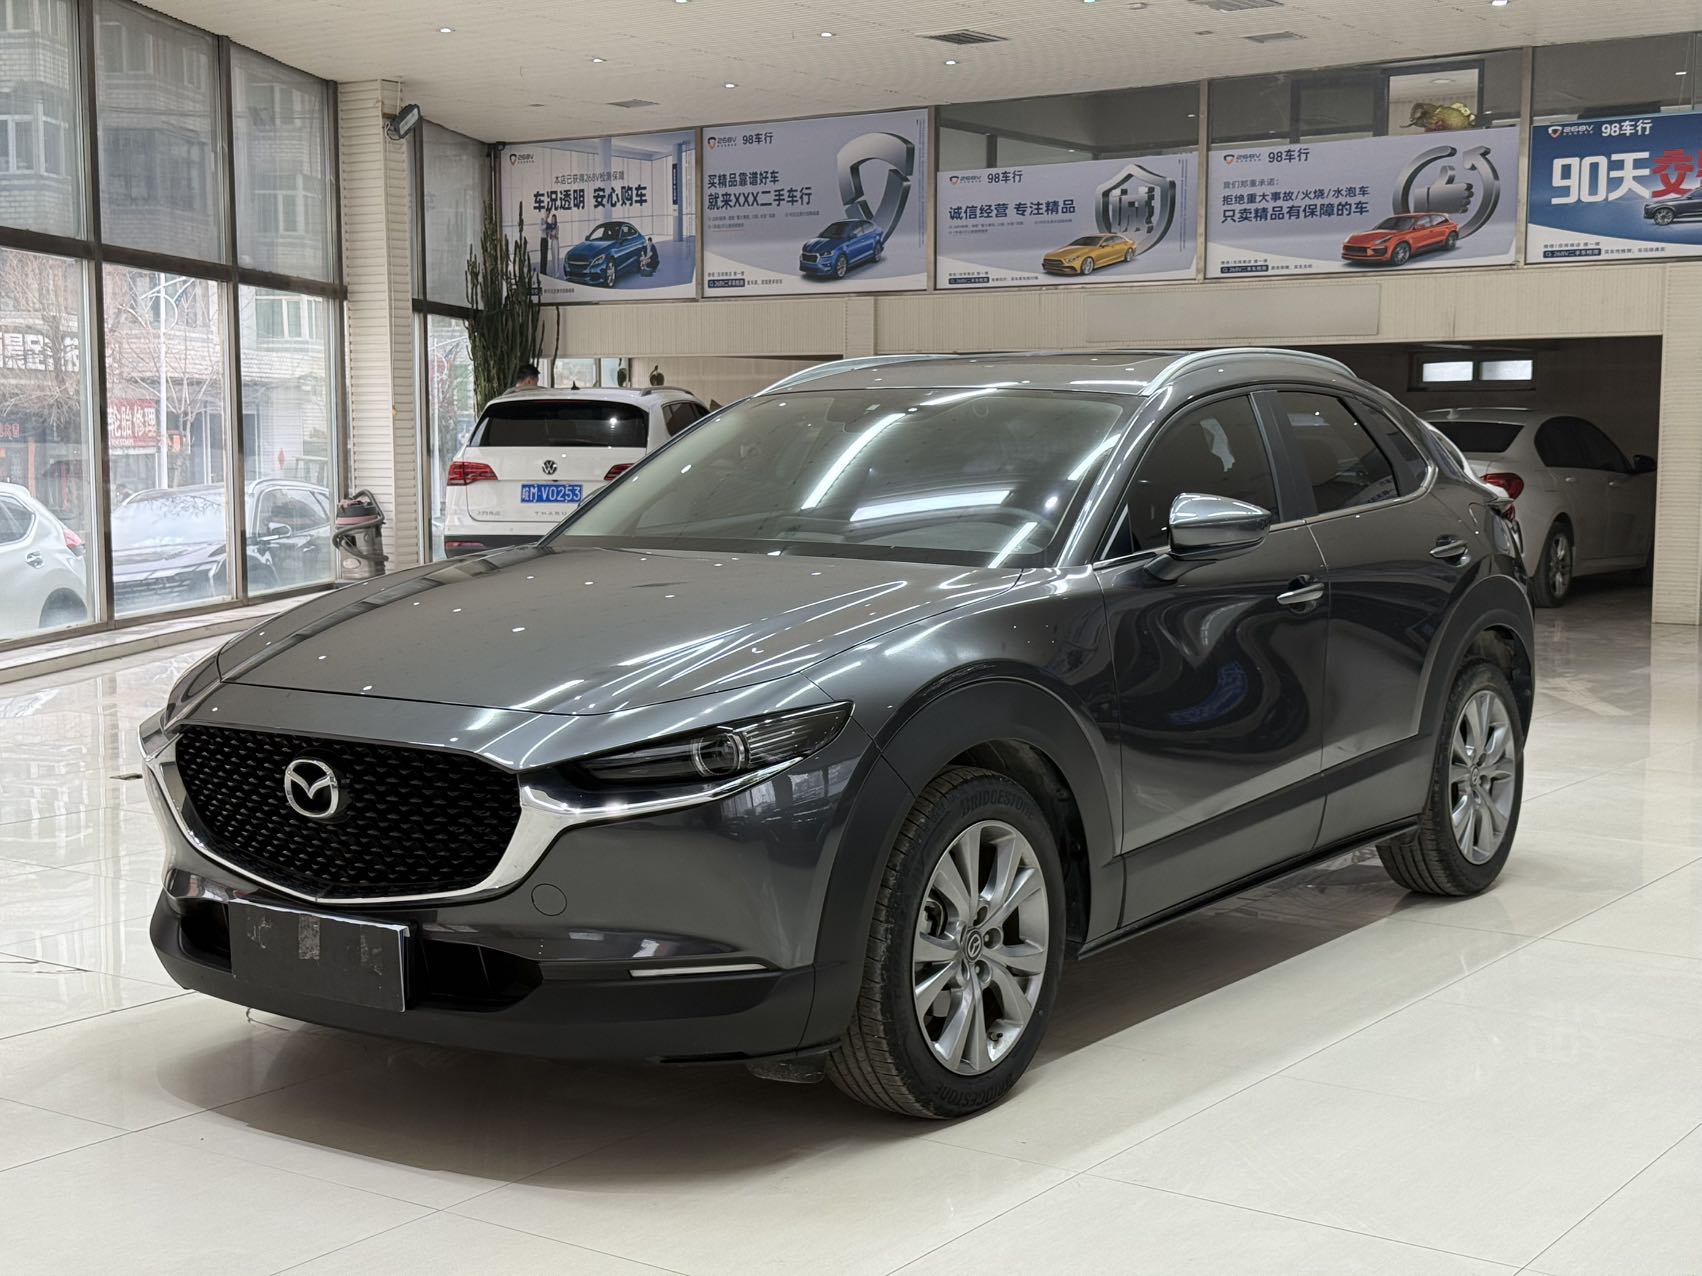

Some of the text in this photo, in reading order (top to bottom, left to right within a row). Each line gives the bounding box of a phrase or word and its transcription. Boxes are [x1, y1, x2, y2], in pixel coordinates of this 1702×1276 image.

[1601, 120, 1653, 136] 98车行
[742, 132, 774, 145] 98车行
[1268, 147, 1310, 163] 98车行
[707, 170, 780, 189] 买精品靠谱好车
[987, 170, 1023, 184] 98车行
[1551, 148, 1702, 205] 90天交
[533, 184, 648, 213] 车况透明 安心购车
[707, 187, 813, 210] 就来XXX二手车行
[948, 199, 1076, 221] 诚信经营 专注精品
[1221, 200, 1370, 223] 只卖精品有保障的车
